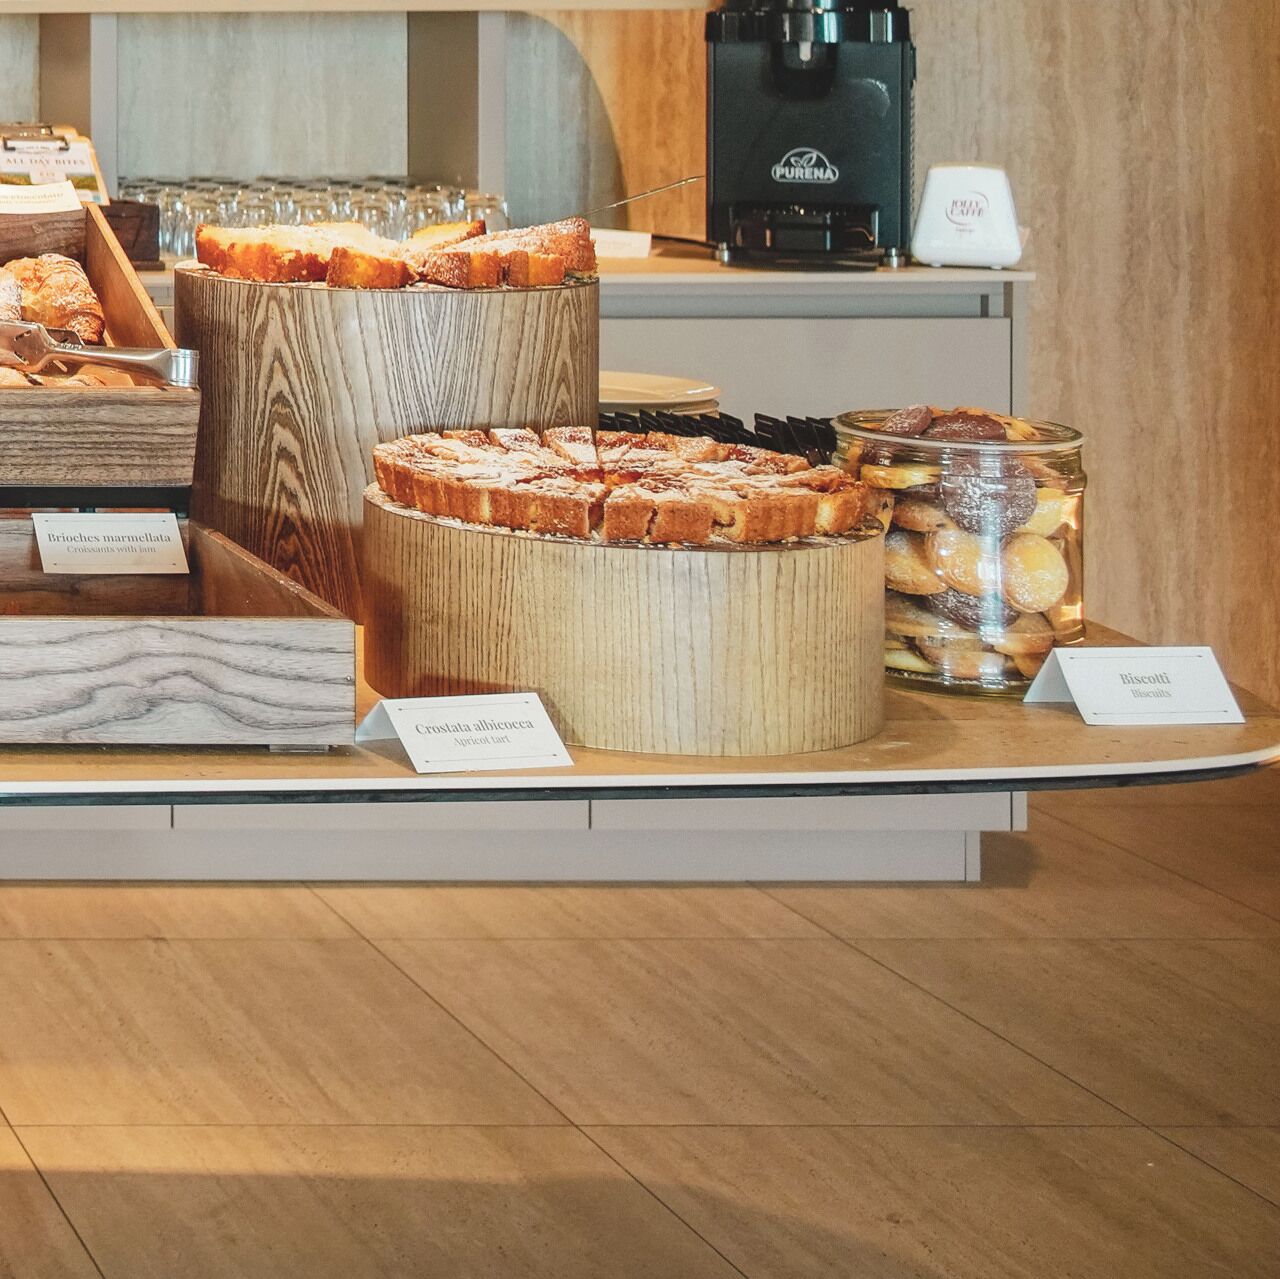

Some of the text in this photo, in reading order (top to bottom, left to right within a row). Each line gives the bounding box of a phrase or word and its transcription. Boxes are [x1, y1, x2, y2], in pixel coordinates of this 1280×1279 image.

[776, 166, 835, 181] PURENA
[47, 532, 171, 543] Brioches marmellata
[67, 545, 156, 554] Croissants with jam
[1119, 672, 1171, 685] Biscotti
[1130, 688, 1172, 698] Biscuits
[414, 718, 534, 735] Crostata albicocca
[453, 734, 511, 747] Apricot tart
